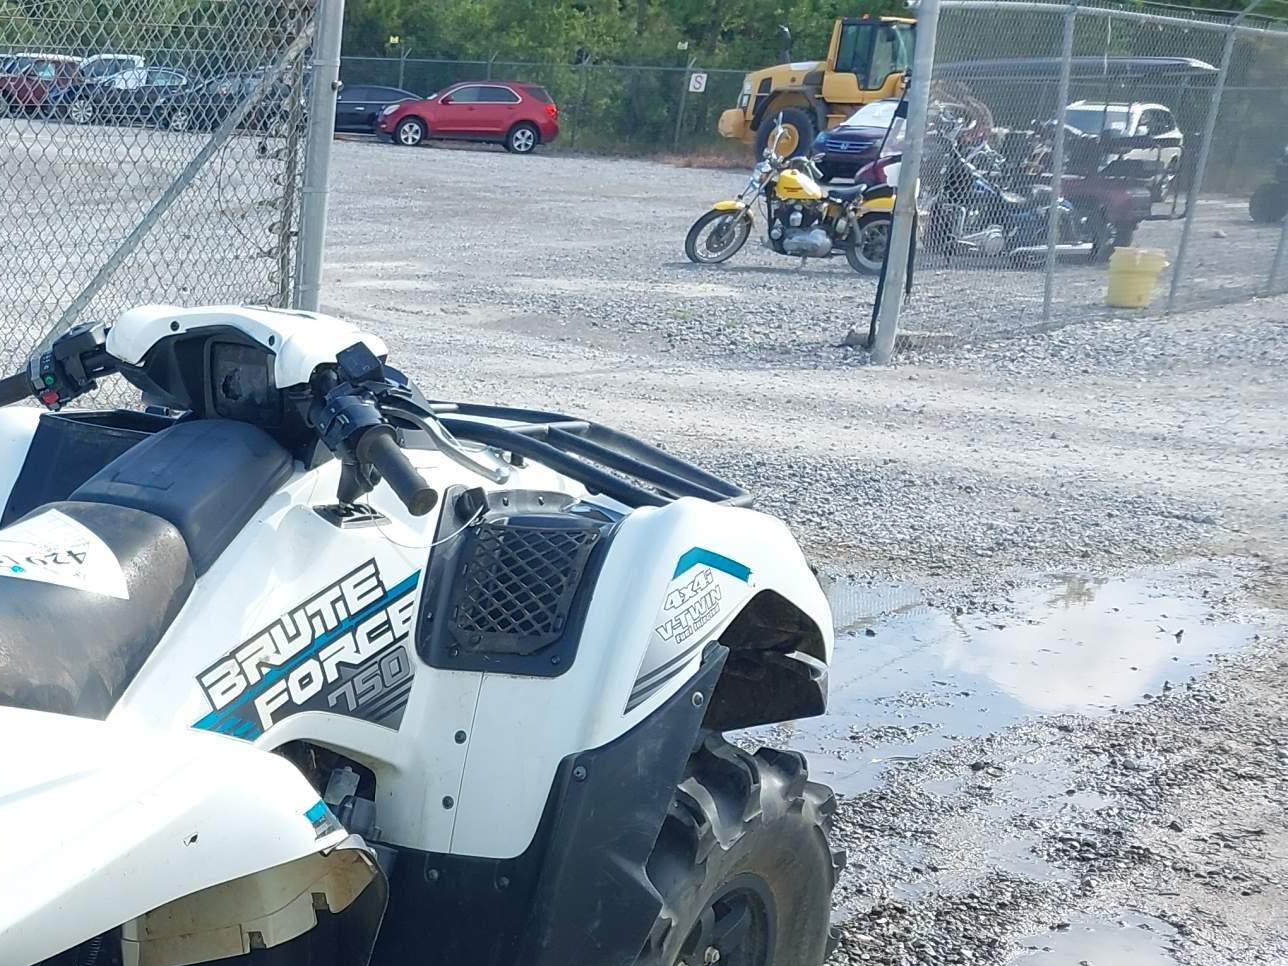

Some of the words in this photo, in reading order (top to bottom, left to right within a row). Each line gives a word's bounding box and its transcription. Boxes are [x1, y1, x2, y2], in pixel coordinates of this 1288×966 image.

[694, 75, 703, 90] S
[196, 557, 389, 711] BRUTE
[655, 584, 722, 641] V-TWIN
[253, 588, 418, 733] FORCE
[326, 645, 411, 712] 750
